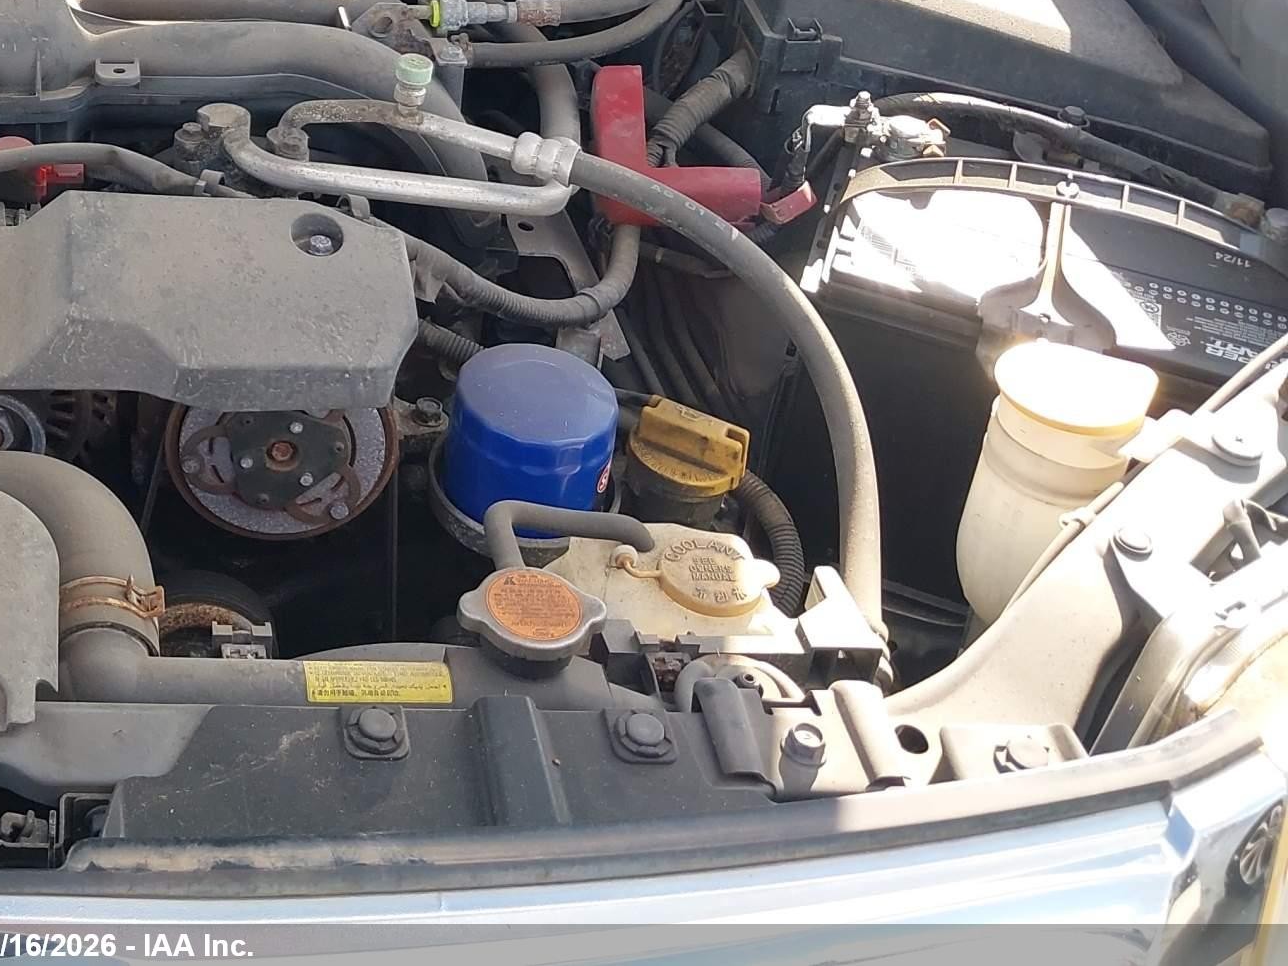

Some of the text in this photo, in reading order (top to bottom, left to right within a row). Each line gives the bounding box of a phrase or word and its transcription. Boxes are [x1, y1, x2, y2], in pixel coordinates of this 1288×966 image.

[1215, 251, 1251, 268] 11/24
[664, 539, 745, 562] COOLANT
[691, 573, 736, 582] MANUAL
